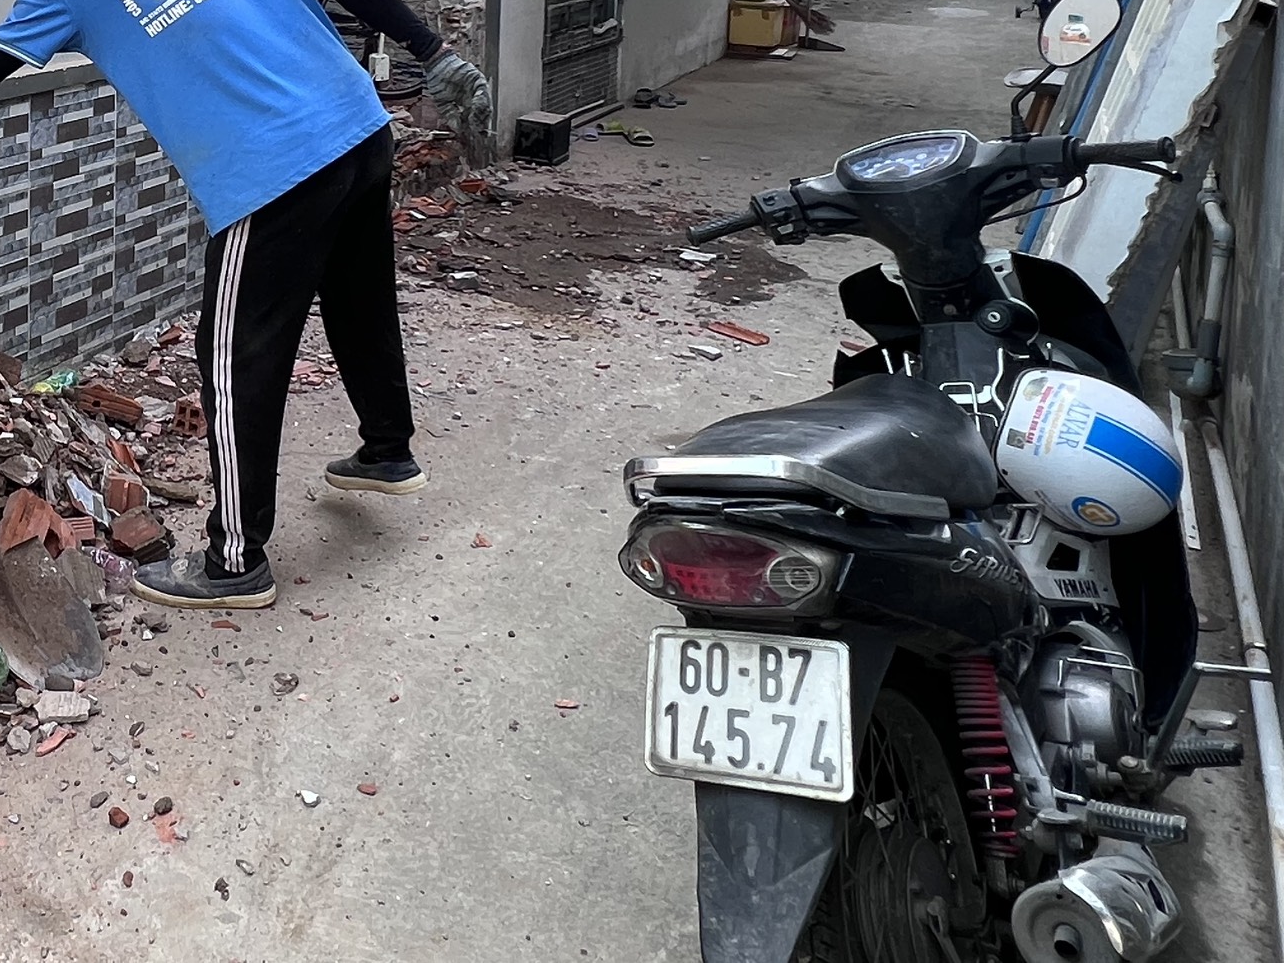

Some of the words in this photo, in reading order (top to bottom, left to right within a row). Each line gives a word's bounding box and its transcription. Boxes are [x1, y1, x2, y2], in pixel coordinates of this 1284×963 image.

[145, 0, 194, 37] HOTLINE:
[1056, 398, 1093, 449] ALVAR
[1054, 578, 1100, 598] YAMAHA
[679, 639, 812, 706] 60-B7
[664, 700, 836, 783] 145.74
